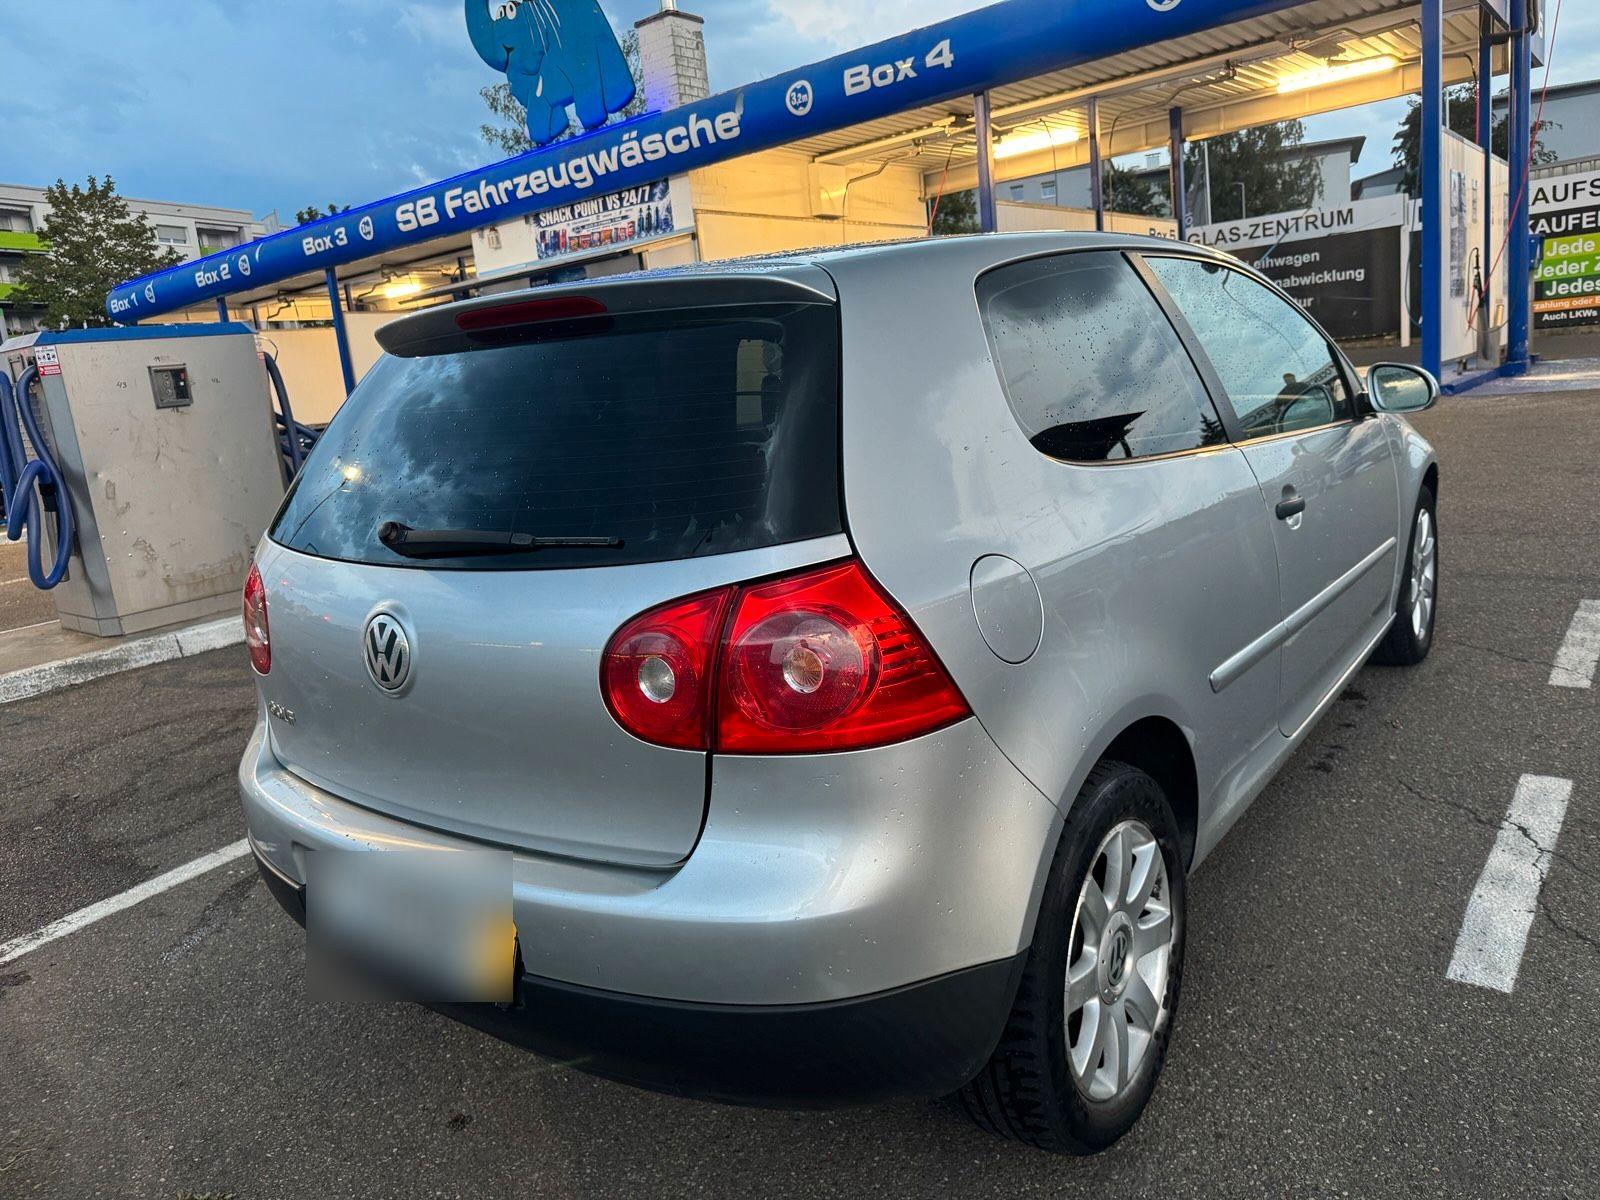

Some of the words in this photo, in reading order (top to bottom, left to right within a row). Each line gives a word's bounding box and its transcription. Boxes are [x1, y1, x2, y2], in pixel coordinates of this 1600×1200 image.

[843, 56, 918, 97] Box
[925, 38, 955, 69] 4
[395, 196, 440, 232] SB
[445, 112, 742, 219] Fahrzeugwäsche
[539, 206, 573, 228] SNACK
[574, 198, 604, 219] POINT
[605, 194, 621, 211] VS
[621, 186, 650, 207] 24/7
[1187, 207, 1354, 246] GLAS-ZENTRUM
[1528, 210, 1600, 235] KAUFE
[302, 236, 331, 256] Box
[334, 227, 348, 246] 3
[1546, 238, 1595, 257] Jede
[1247, 251, 1320, 270] eihwagen
[1534, 259, 1590, 279] Jeder
[195, 270, 220, 288] Box
[220, 263, 231, 279] 2
[110, 300, 131, 314] Box
[130, 292, 138, 307] 1
[1542, 311, 1568, 322] Auch
[1568, 308, 1598, 319] LKWs
